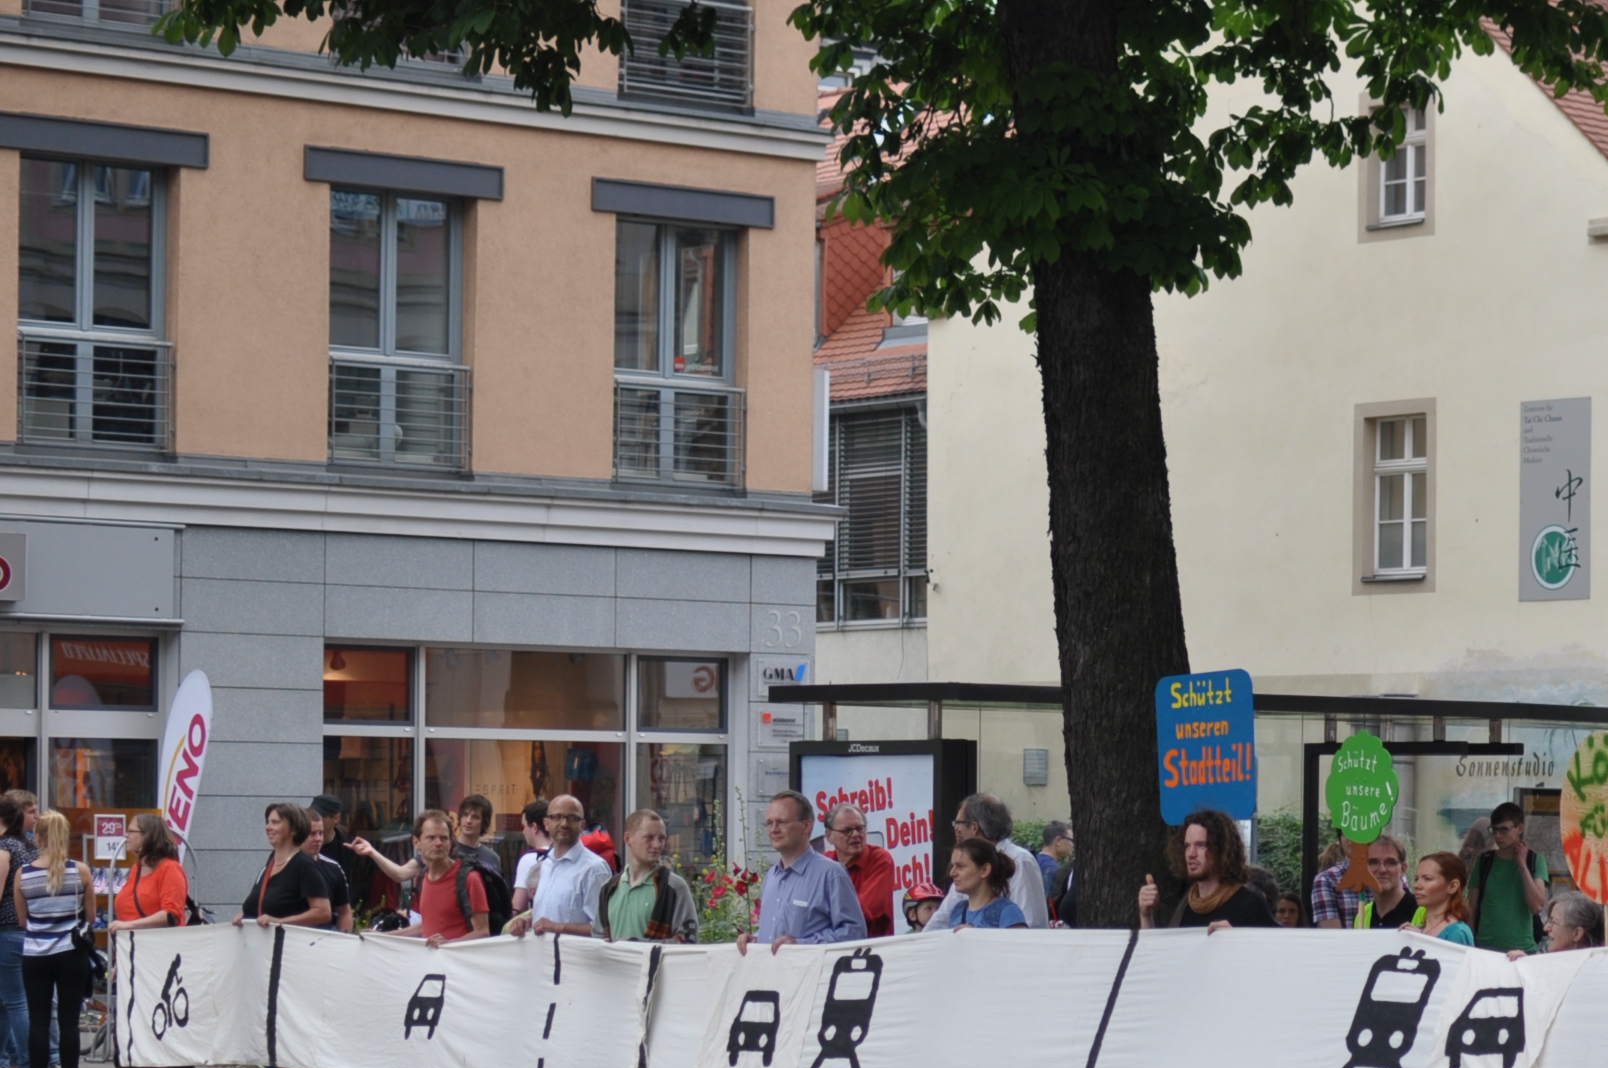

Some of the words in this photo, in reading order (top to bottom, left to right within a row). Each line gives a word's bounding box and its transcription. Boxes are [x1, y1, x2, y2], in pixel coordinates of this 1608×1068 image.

[765, 609, 801, 648] 33
[763, 667, 795, 681] GMA
[1170, 677, 1232, 709] Schützt
[1176, 720, 1229, 739] unseren
[848, 743, 880, 753] JCDecaux
[1163, 742, 1252, 788] Stadtteil!
[1338, 749, 1378, 773] Schützt
[1456, 752, 1554, 778] Sonnenstudio
[166, 714, 206, 846] ENO
[476, 784, 516, 796] ESPRIT
[1346, 785, 1381, 798] unsere
[886, 810, 935, 850] Dein!
